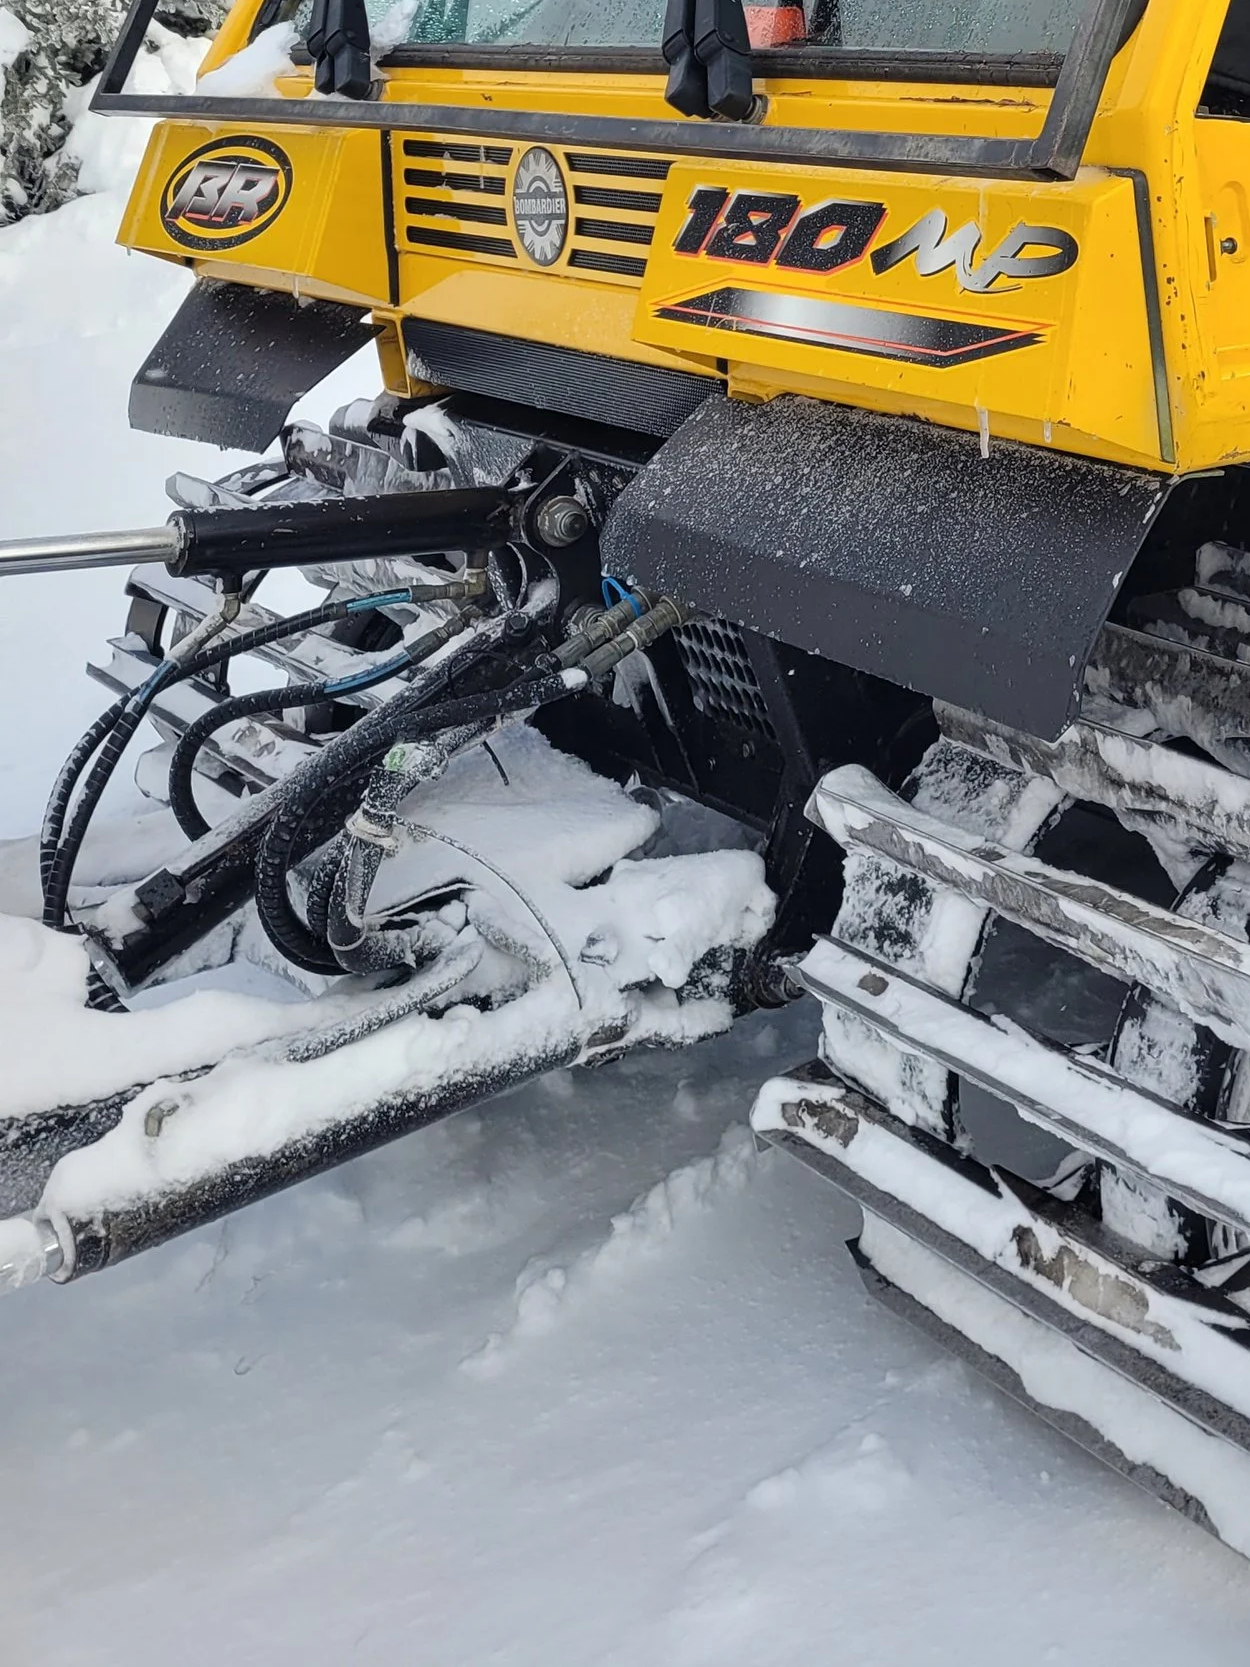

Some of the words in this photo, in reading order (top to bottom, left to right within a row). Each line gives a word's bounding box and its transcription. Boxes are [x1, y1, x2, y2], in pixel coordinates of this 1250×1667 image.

[513, 196, 567, 215] BOMBARDIER
[671, 183, 889, 276] 180
[868, 208, 1080, 295] MP
